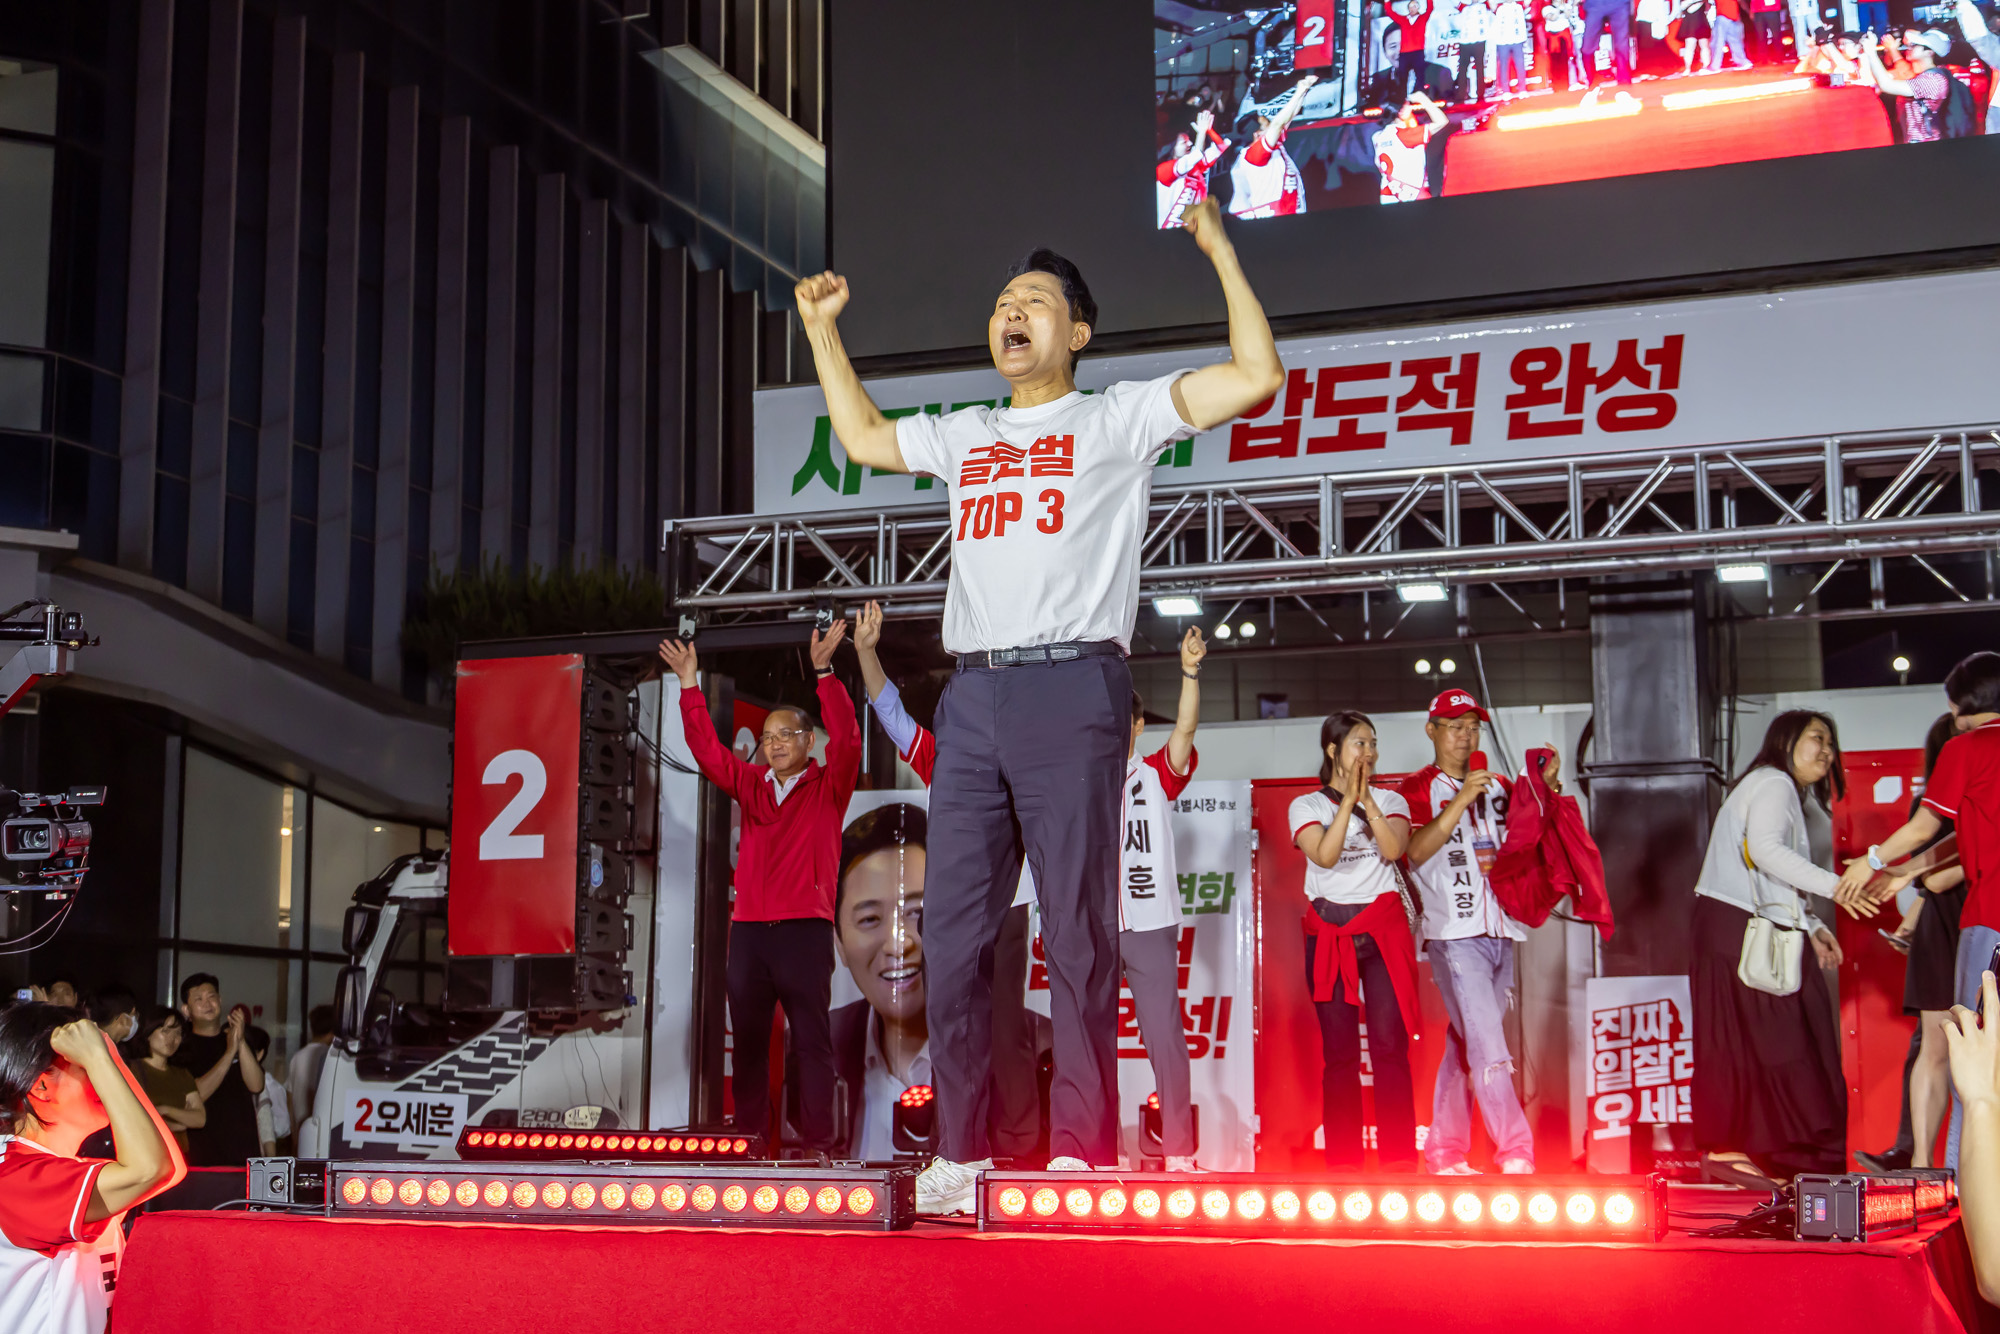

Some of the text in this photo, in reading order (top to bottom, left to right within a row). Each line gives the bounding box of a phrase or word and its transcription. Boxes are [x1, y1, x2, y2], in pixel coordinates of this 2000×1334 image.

[1303, 15, 1326, 46] 2
[1228, 333, 1686, 463] 압도적 완성
[959, 434, 1074, 488] 글로벌
[956, 488, 1065, 542] TOP 3
[479, 749, 547, 861] 2
[1219, 801, 1237, 811] 후보
[1593, 1000, 1674, 1051] 진짜
[375, 1101, 454, 1137] 오세훈
[521, 1109, 561, 1123] 280
